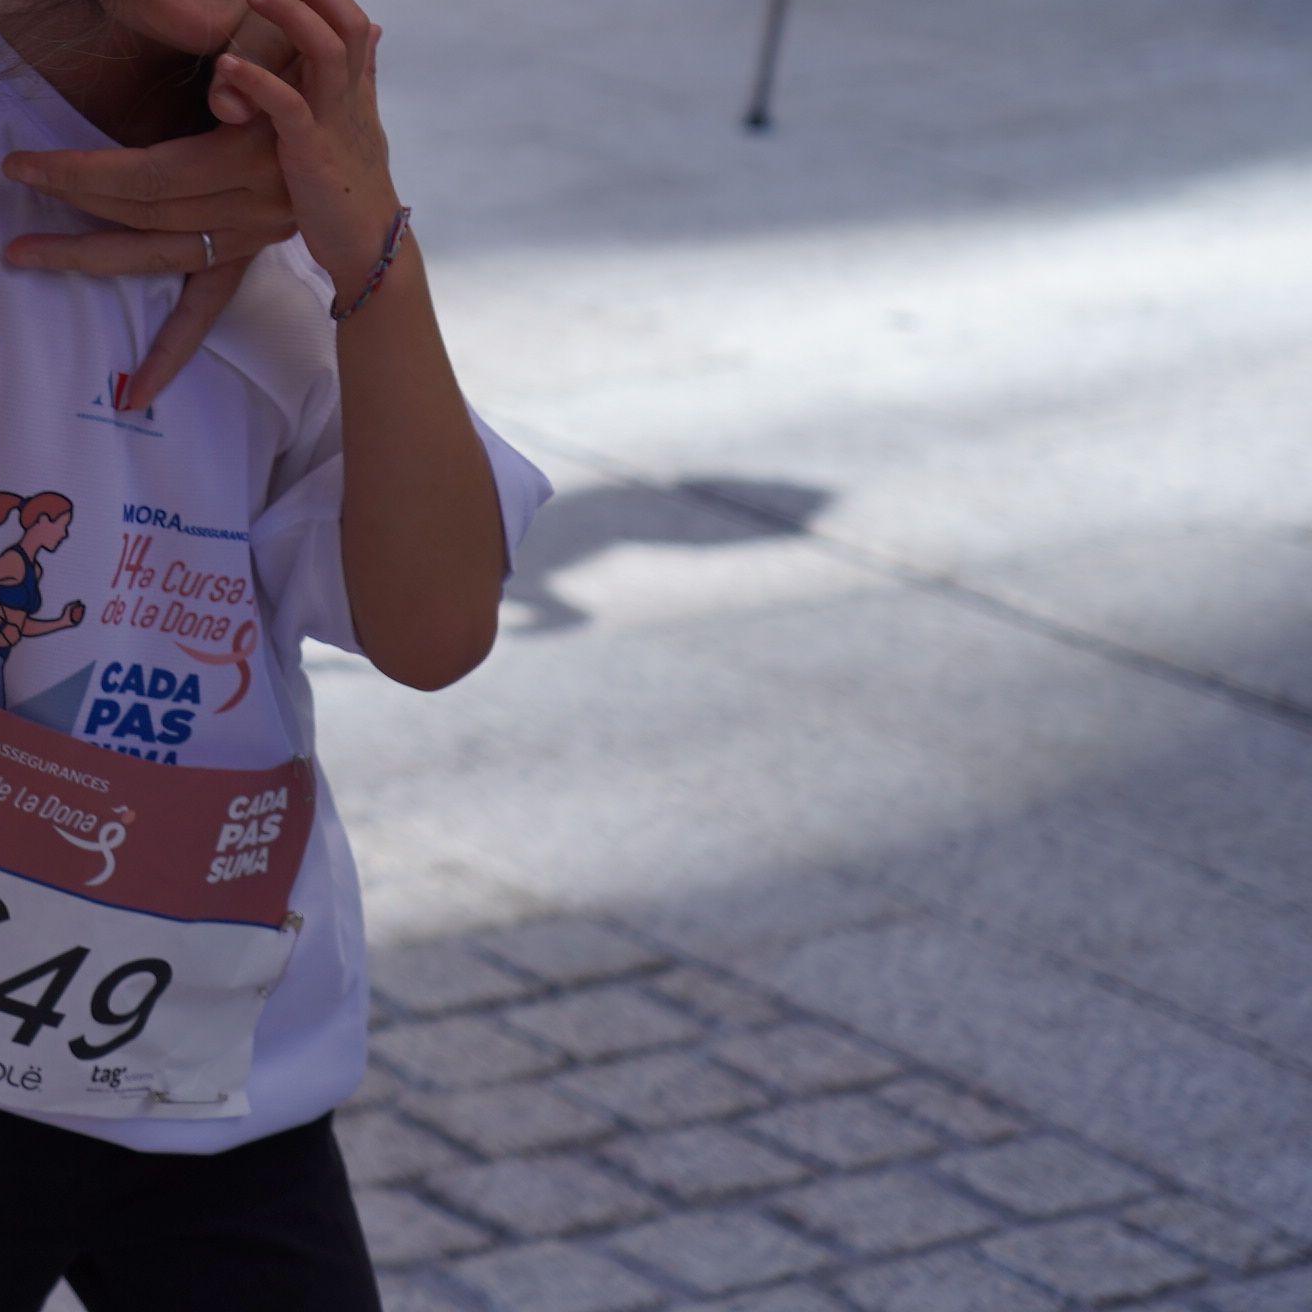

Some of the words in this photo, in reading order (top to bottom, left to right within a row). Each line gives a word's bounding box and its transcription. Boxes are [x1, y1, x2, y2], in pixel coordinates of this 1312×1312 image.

[123, 503, 182, 532] MORA
[161, 561, 246, 605] Cursa
[101, 594, 126, 625] de
[130, 596, 159, 628] la
[160, 601, 231, 640] Dona
[101, 661, 201, 704] CADA
[84, 698, 196, 745] PAS
[14, 787, 39, 812] la
[39, 796, 98, 832] Dona
[228, 787, 288, 820] CADA
[217, 814, 283, 852] PAS
[206, 847, 269, 884] SUMA
